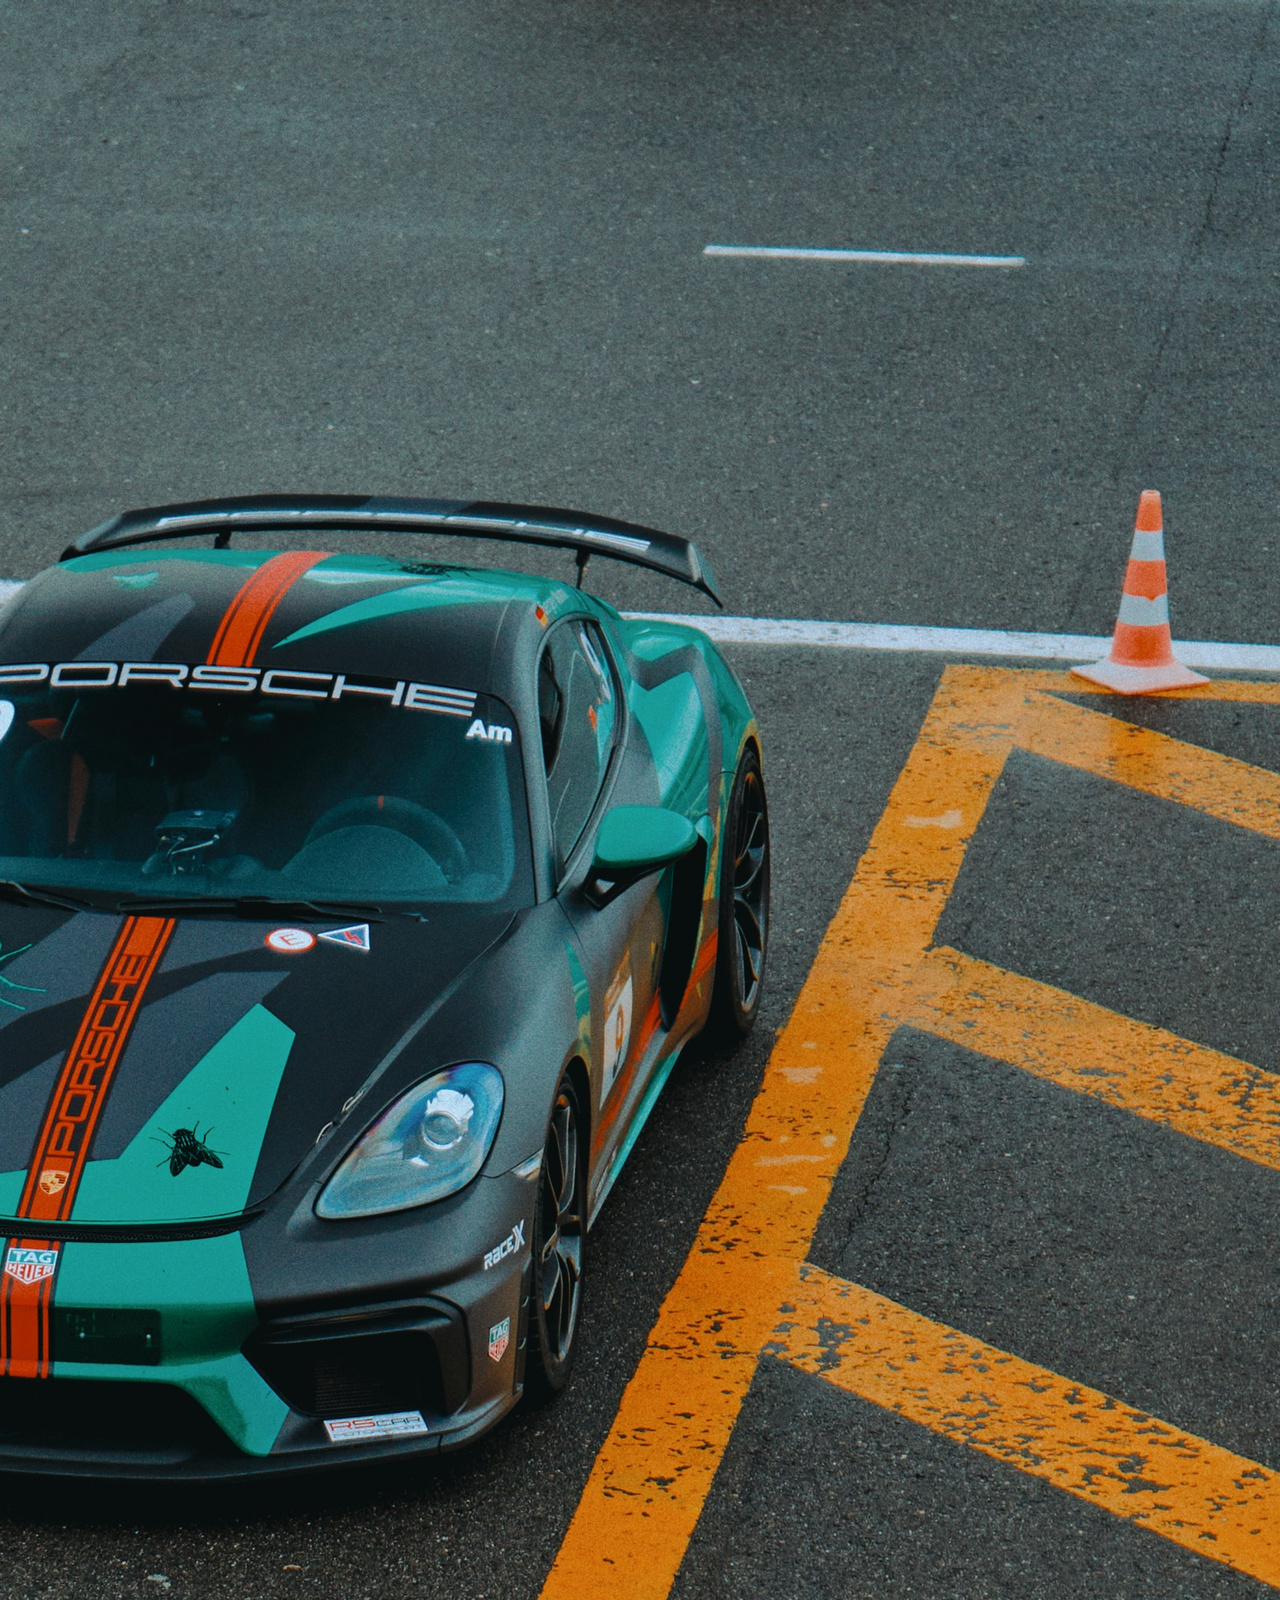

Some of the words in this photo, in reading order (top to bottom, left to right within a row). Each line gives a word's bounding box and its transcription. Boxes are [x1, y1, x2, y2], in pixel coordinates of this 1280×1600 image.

[466, 719, 513, 742] Am
[279, 933, 305, 946] E
[46, 954, 149, 1157] PORSCHE
[12, 1250, 53, 1263] TAG
[8, 1263, 52, 1281] HEUER
[491, 1321, 508, 1341] TAG
